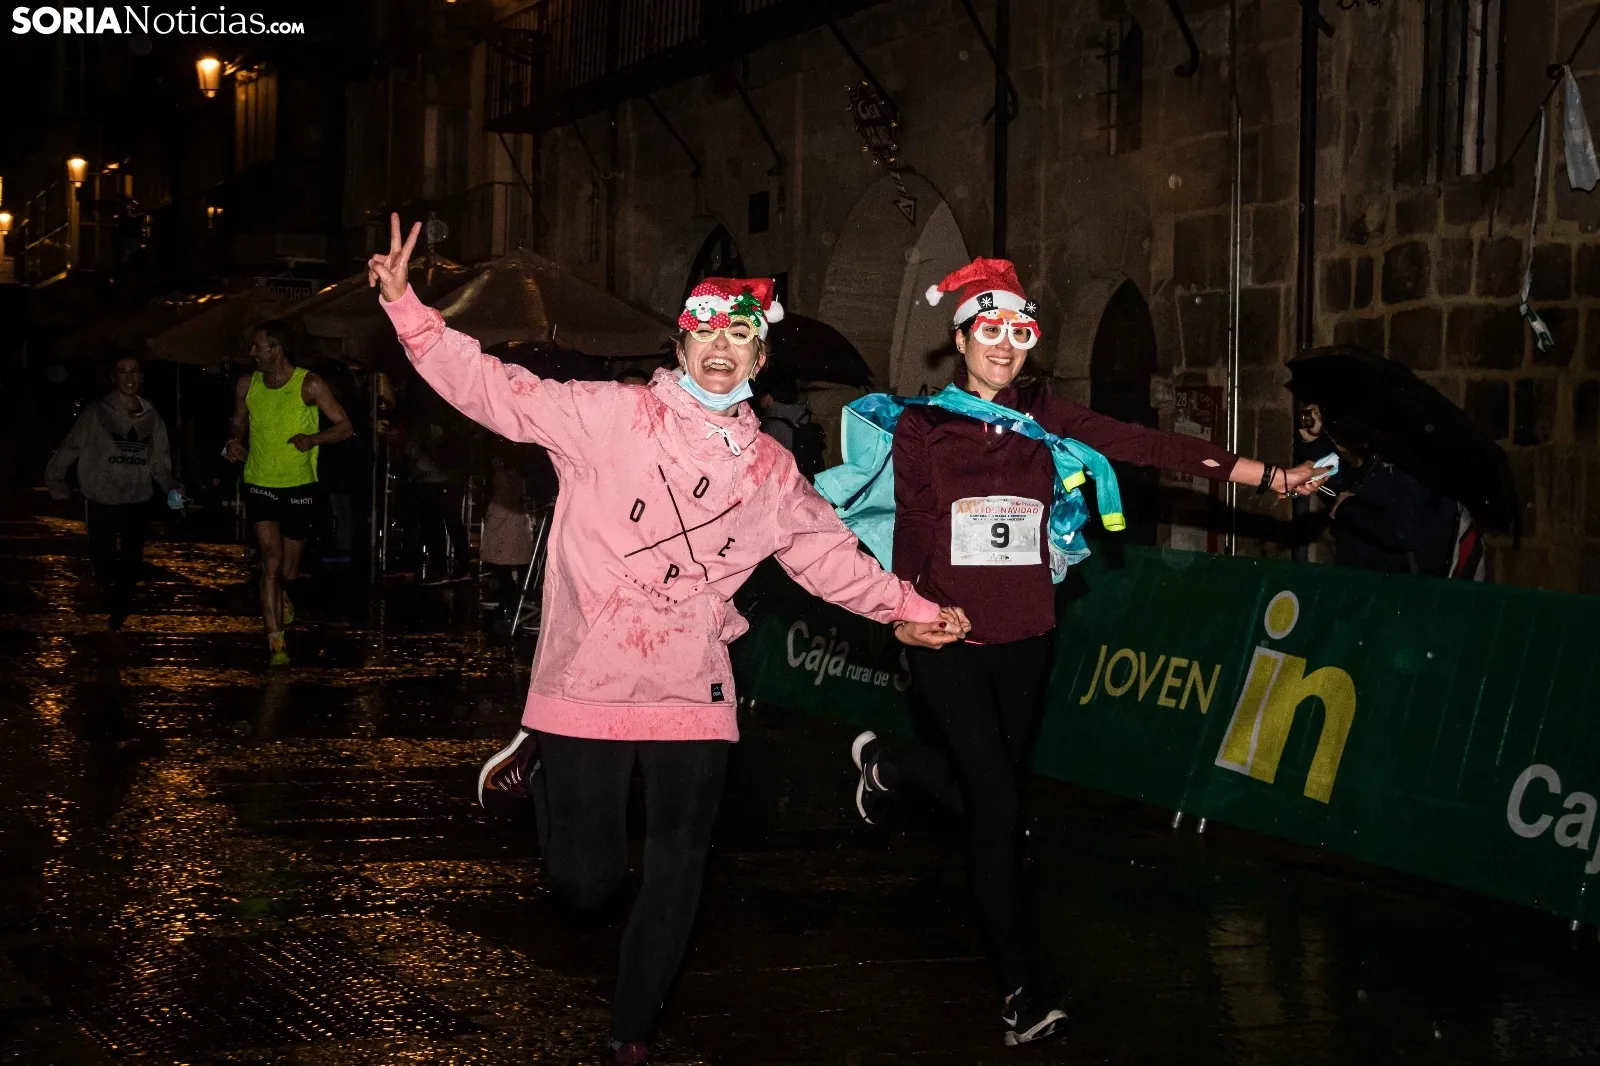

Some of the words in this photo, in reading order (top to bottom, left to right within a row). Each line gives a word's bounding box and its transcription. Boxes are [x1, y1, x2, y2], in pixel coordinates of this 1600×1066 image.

[109, 454, 148, 465] adidas
[1000, 506, 1039, 514] NAVIDAD
[990, 522, 1010, 548] 9
[663, 563, 680, 584] P
[786, 620, 850, 687] Caja
[845, 663, 873, 683] rural
[873, 671, 890, 687] de
[1079, 644, 1222, 715] JOVEN
[1213, 589, 1358, 805] in
